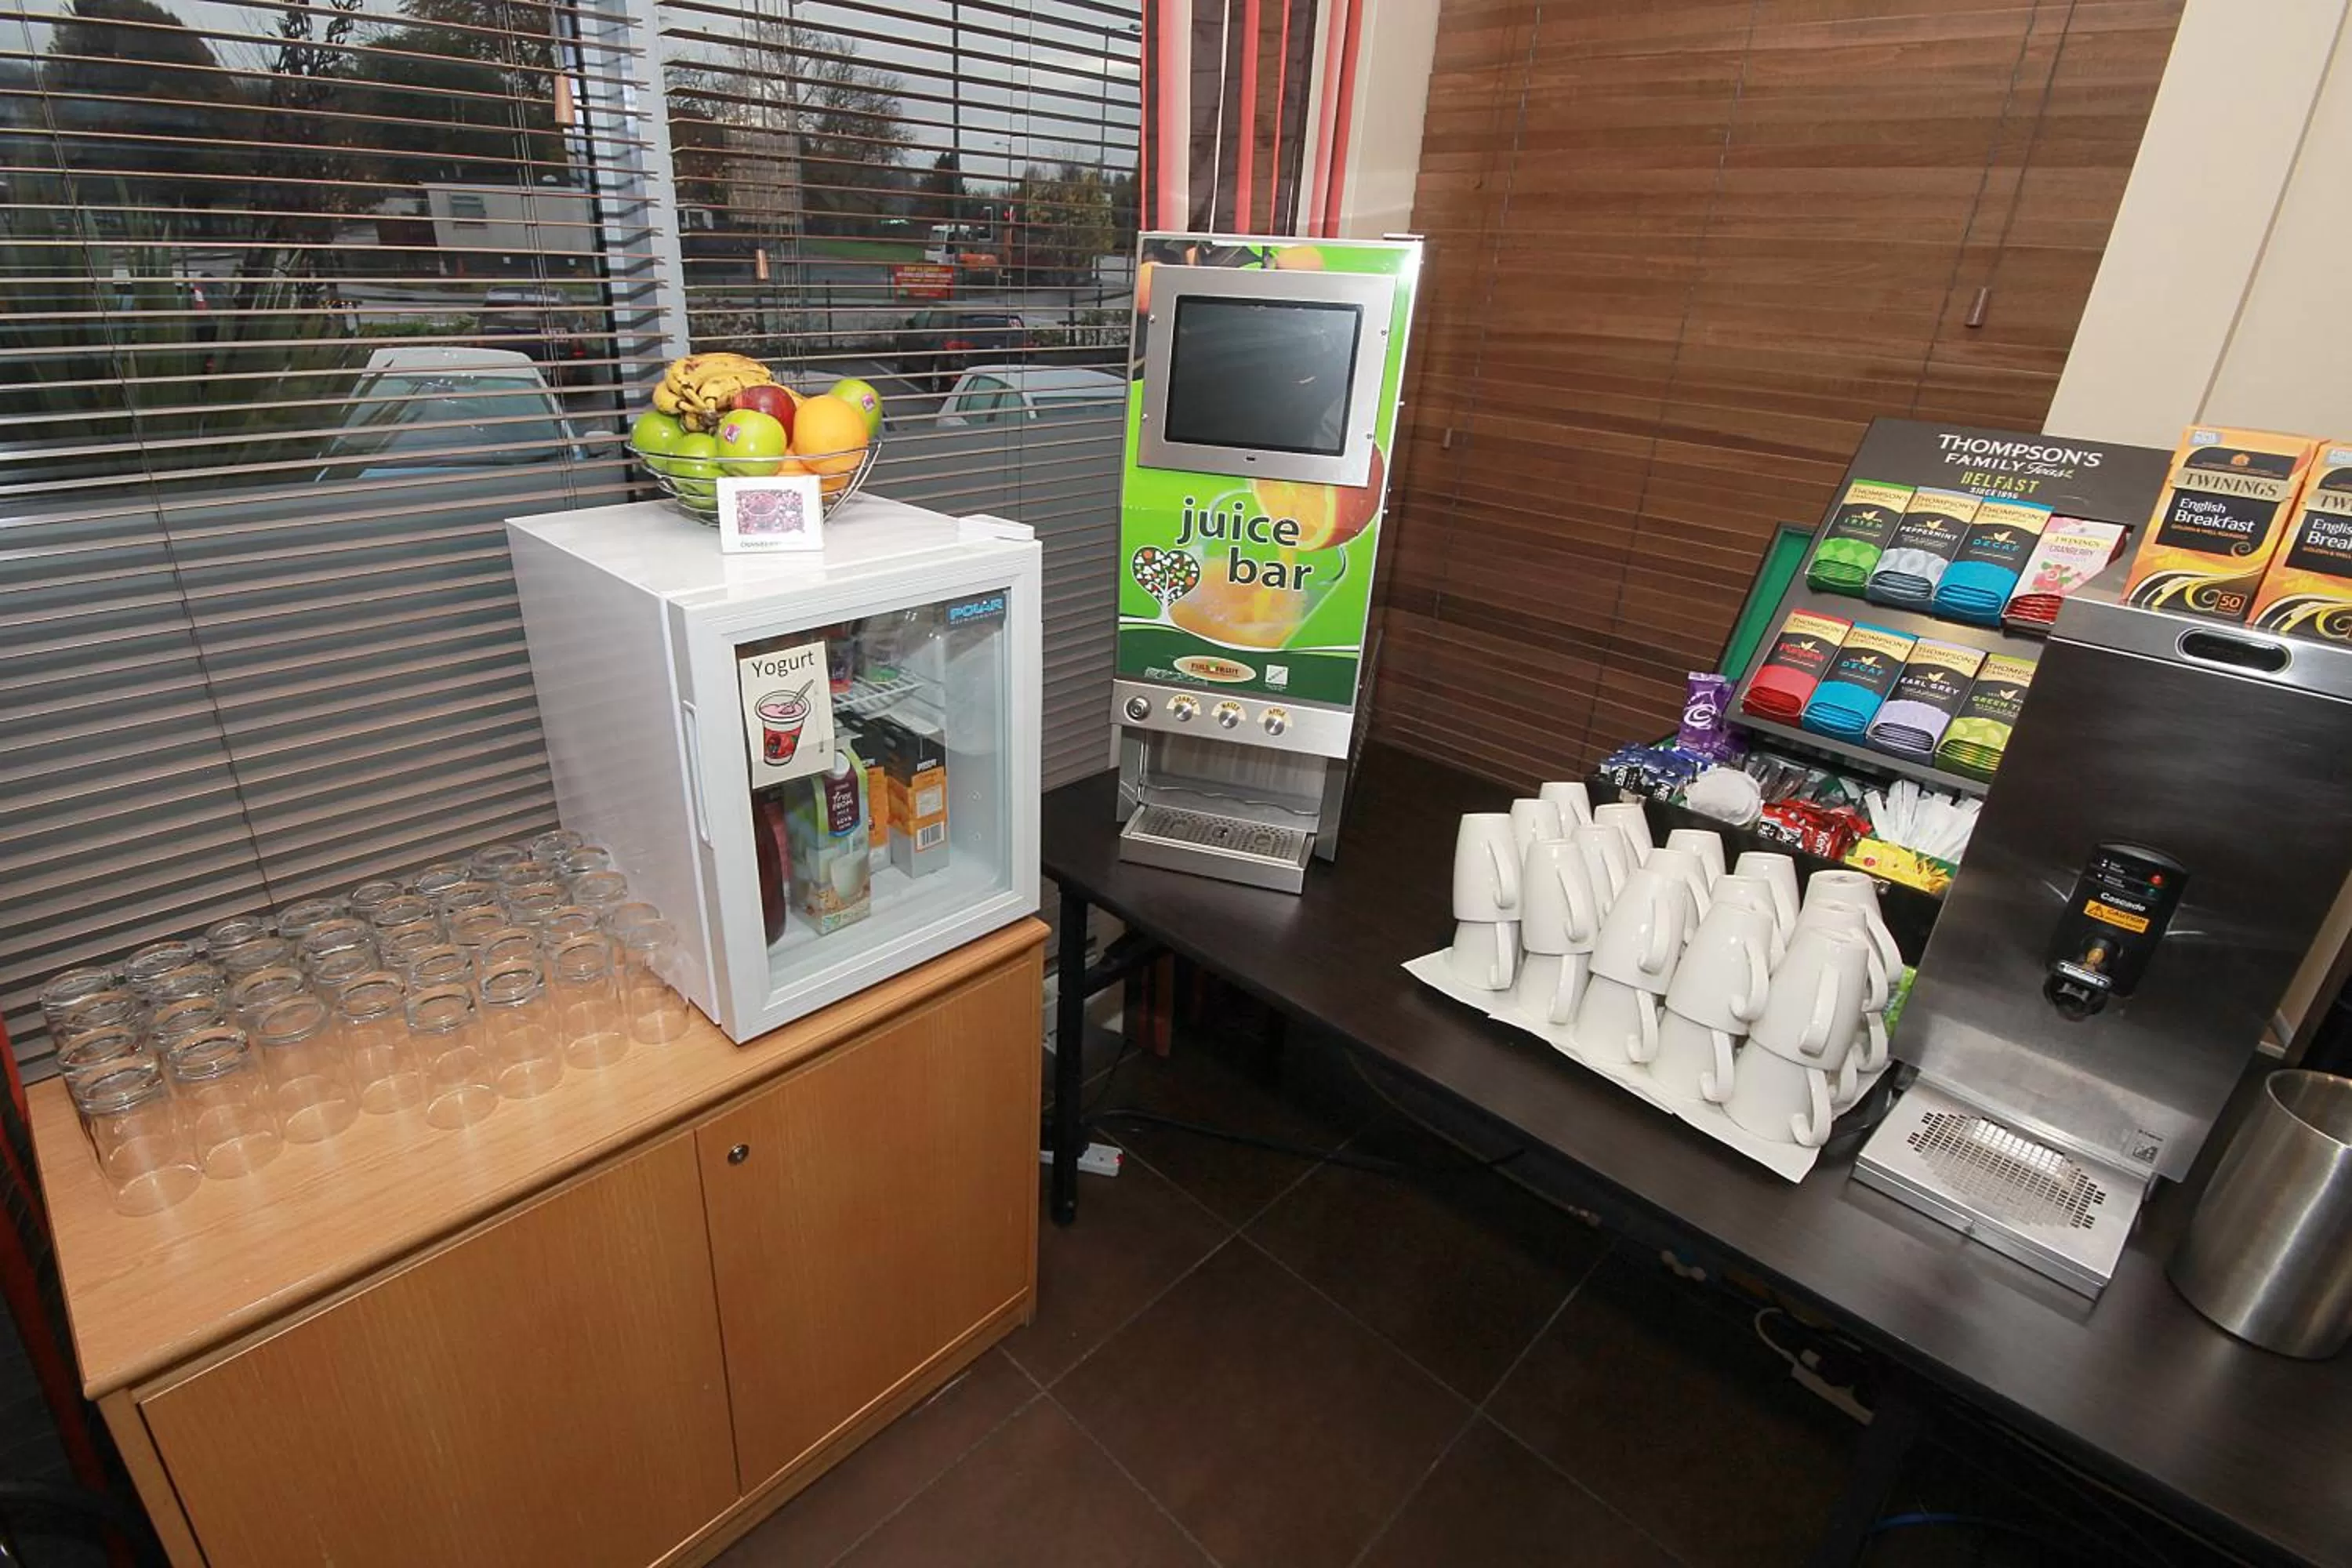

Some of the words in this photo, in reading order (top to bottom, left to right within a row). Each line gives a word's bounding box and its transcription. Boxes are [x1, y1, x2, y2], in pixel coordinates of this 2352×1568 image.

[1938, 434, 2103, 467] THOMPSON'S
[1944, 452, 2027, 472] FAMILY
[1961, 471, 2040, 494] BELFAST
[2184, 472, 2279, 497] TWININGS
[1853, 487, 1908, 500] THOMPSON'S
[1916, 495, 1975, 510] THOMPSON'S
[2321, 493, 2352, 512] TW
[1983, 505, 2045, 522] THOMPSON'S
[2180, 498, 2227, 514] English
[1175, 496, 1300, 546] juice
[2175, 510, 2256, 533] Breakfast
[2312, 518, 2352, 535] Englis
[1900, 525, 1958, 541] PEPPERMINT
[1972, 539, 2020, 551] DECAF
[1229, 546, 1313, 590] bar
[949, 598, 1004, 621] POLAR
[2220, 595, 2241, 608] 50
[1853, 631, 1908, 649] THOMPSON'S
[752, 651, 815, 678] Yogurt
[1919, 647, 1978, 665] THOMPSON'S
[1842, 660, 1886, 675] DECAF
[1900, 677, 1926, 688] EARL
[1929, 682, 1960, 695] GREY
[1972, 695, 2009, 708] GREEN
[2100, 891, 2147, 912] Cascade
[2107, 909, 2147, 924] CAUTION
